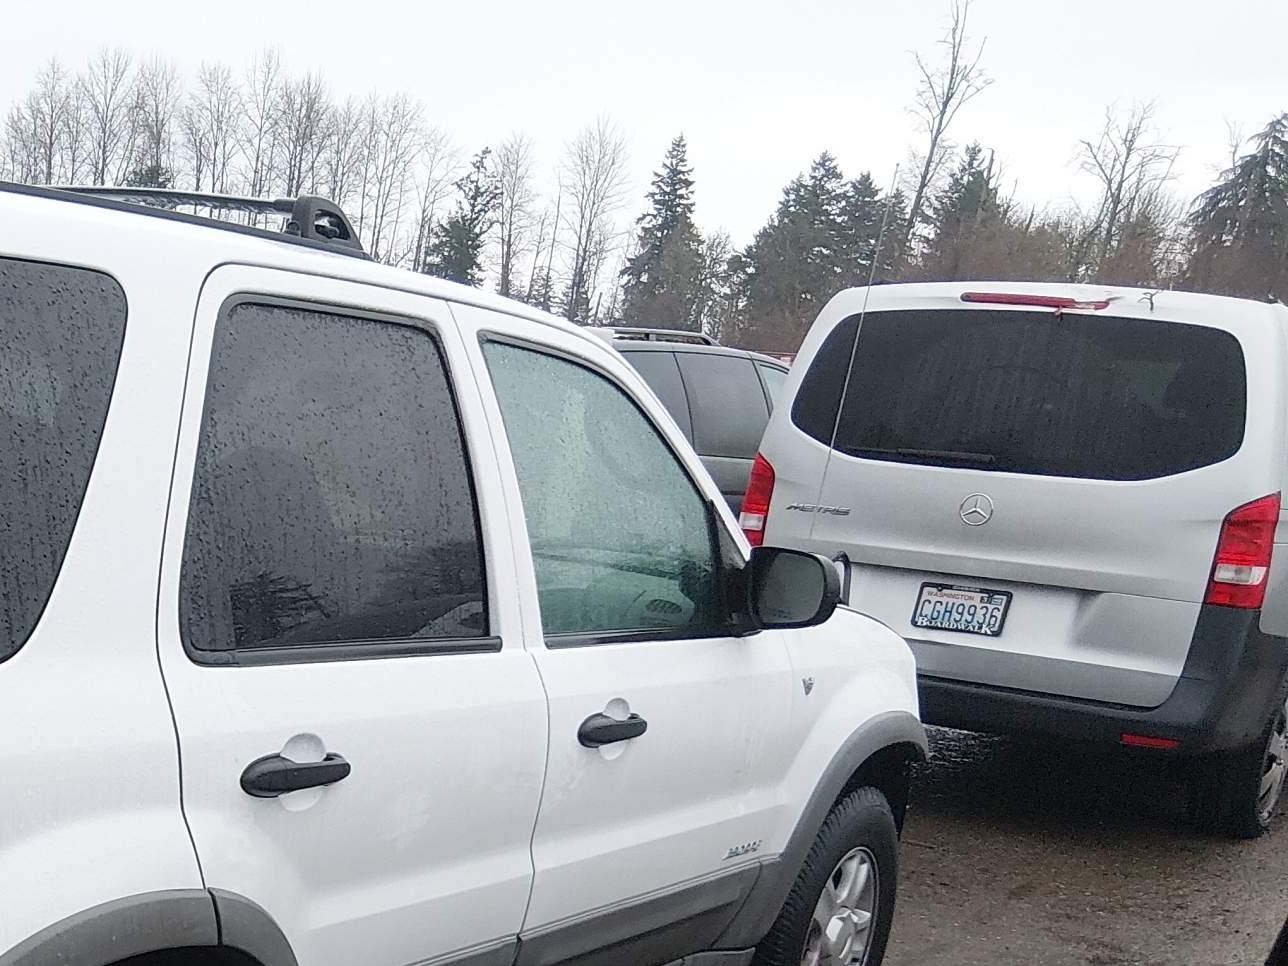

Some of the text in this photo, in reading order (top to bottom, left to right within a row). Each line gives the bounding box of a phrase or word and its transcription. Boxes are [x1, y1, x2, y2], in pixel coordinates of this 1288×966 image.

[927, 590, 975, 602] WASHINGTON
[919, 599, 1001, 628] CGH9936
[916, 616, 993, 635] BOARDWALK
